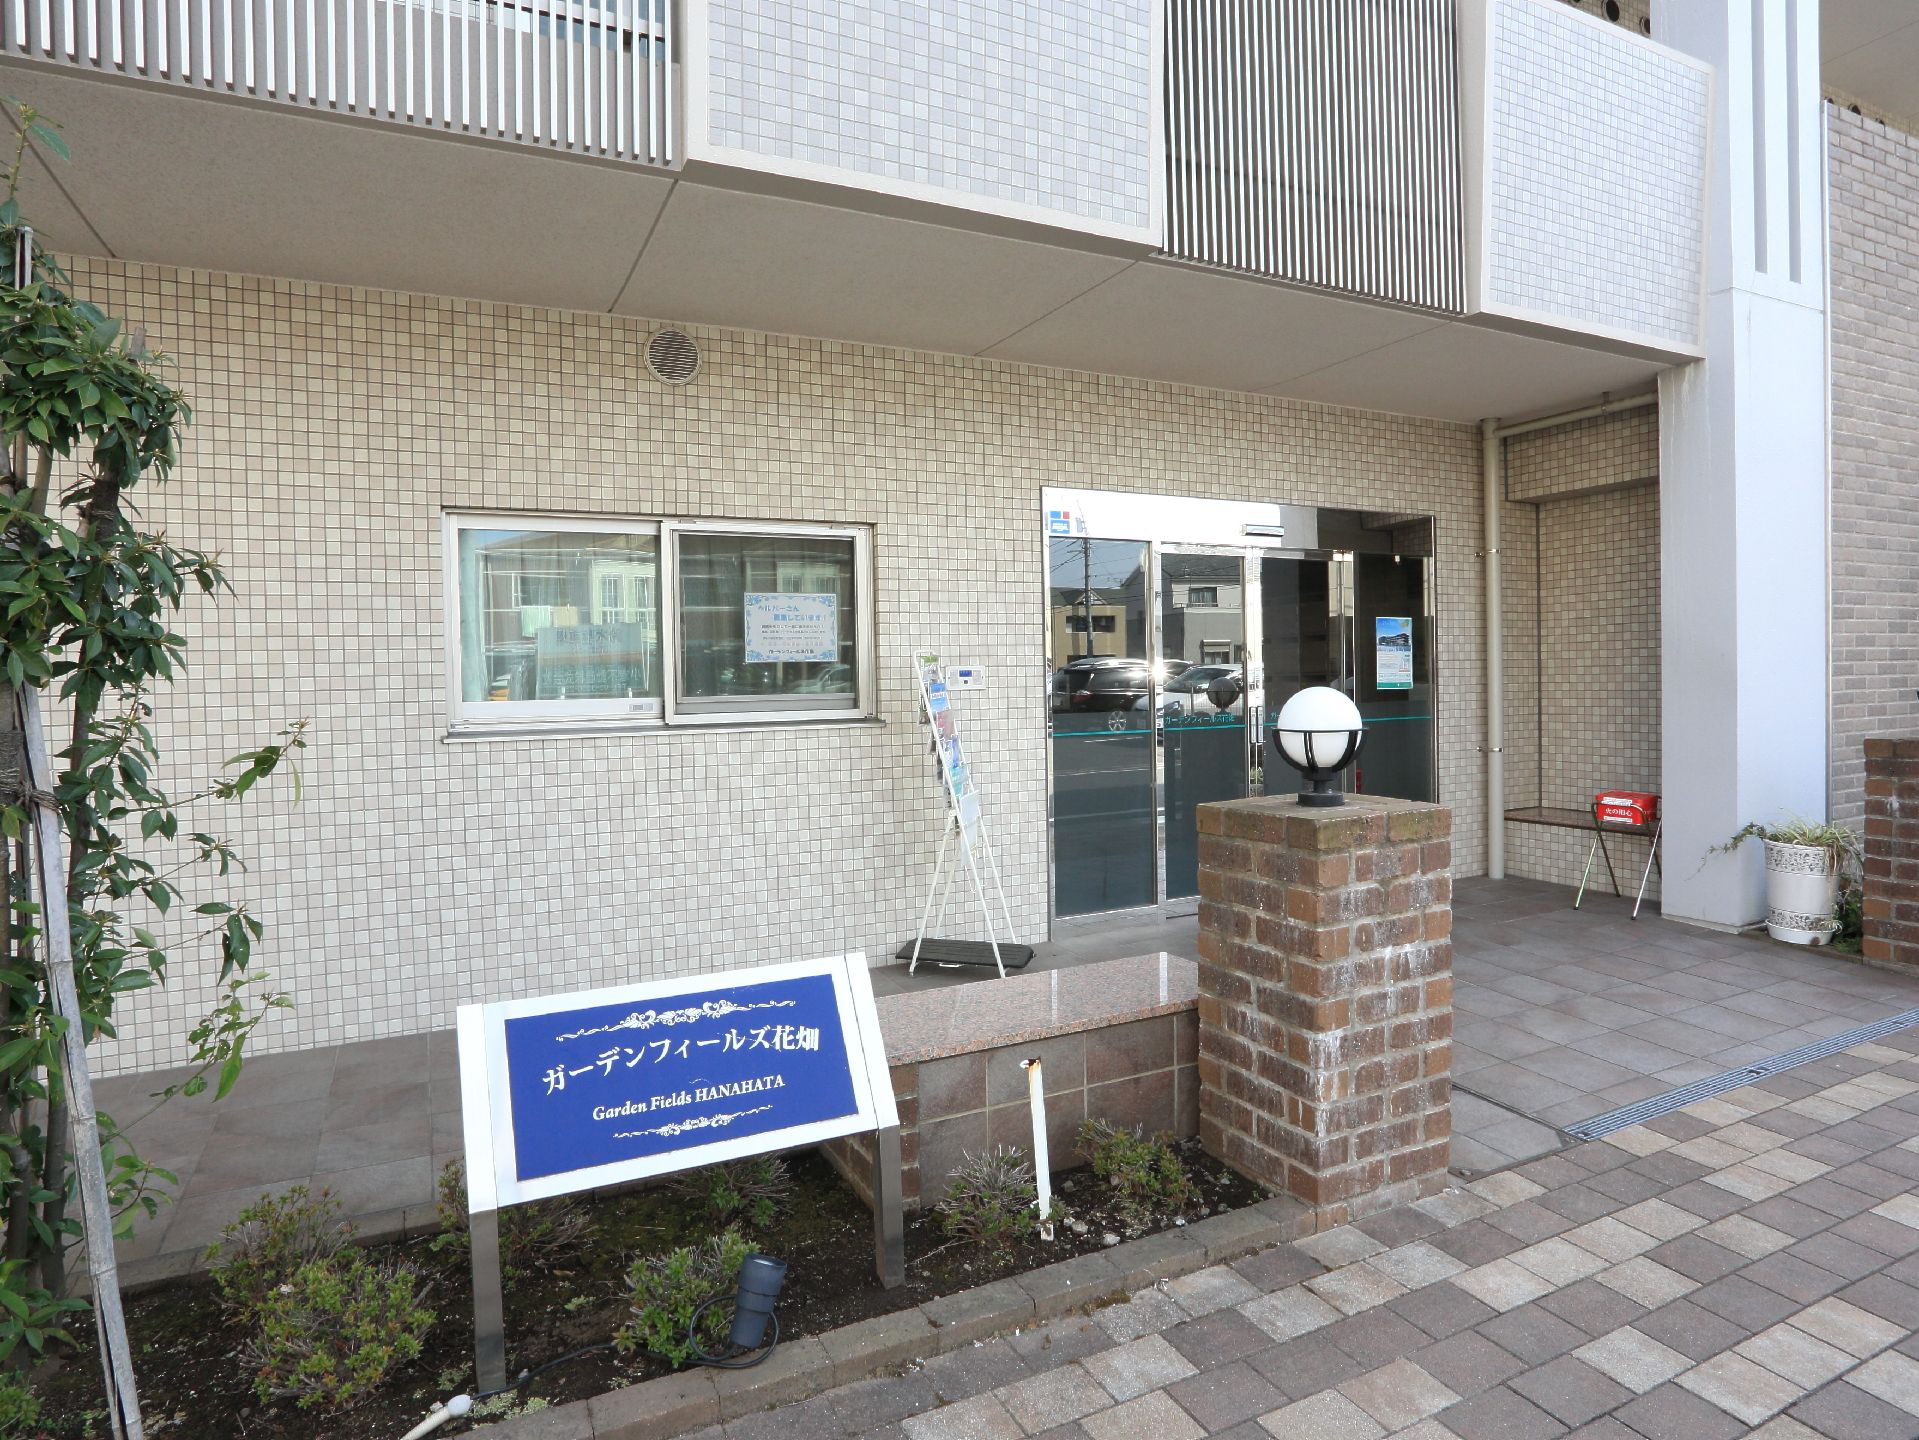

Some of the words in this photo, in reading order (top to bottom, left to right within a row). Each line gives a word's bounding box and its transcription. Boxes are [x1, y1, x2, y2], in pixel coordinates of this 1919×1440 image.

[542, 1024, 820, 1096] ガーデンフィールズ花畑
[592, 1100, 648, 1121] Garden
[649, 1090, 692, 1111] Fields
[694, 1074, 786, 1103] HANAHATA
